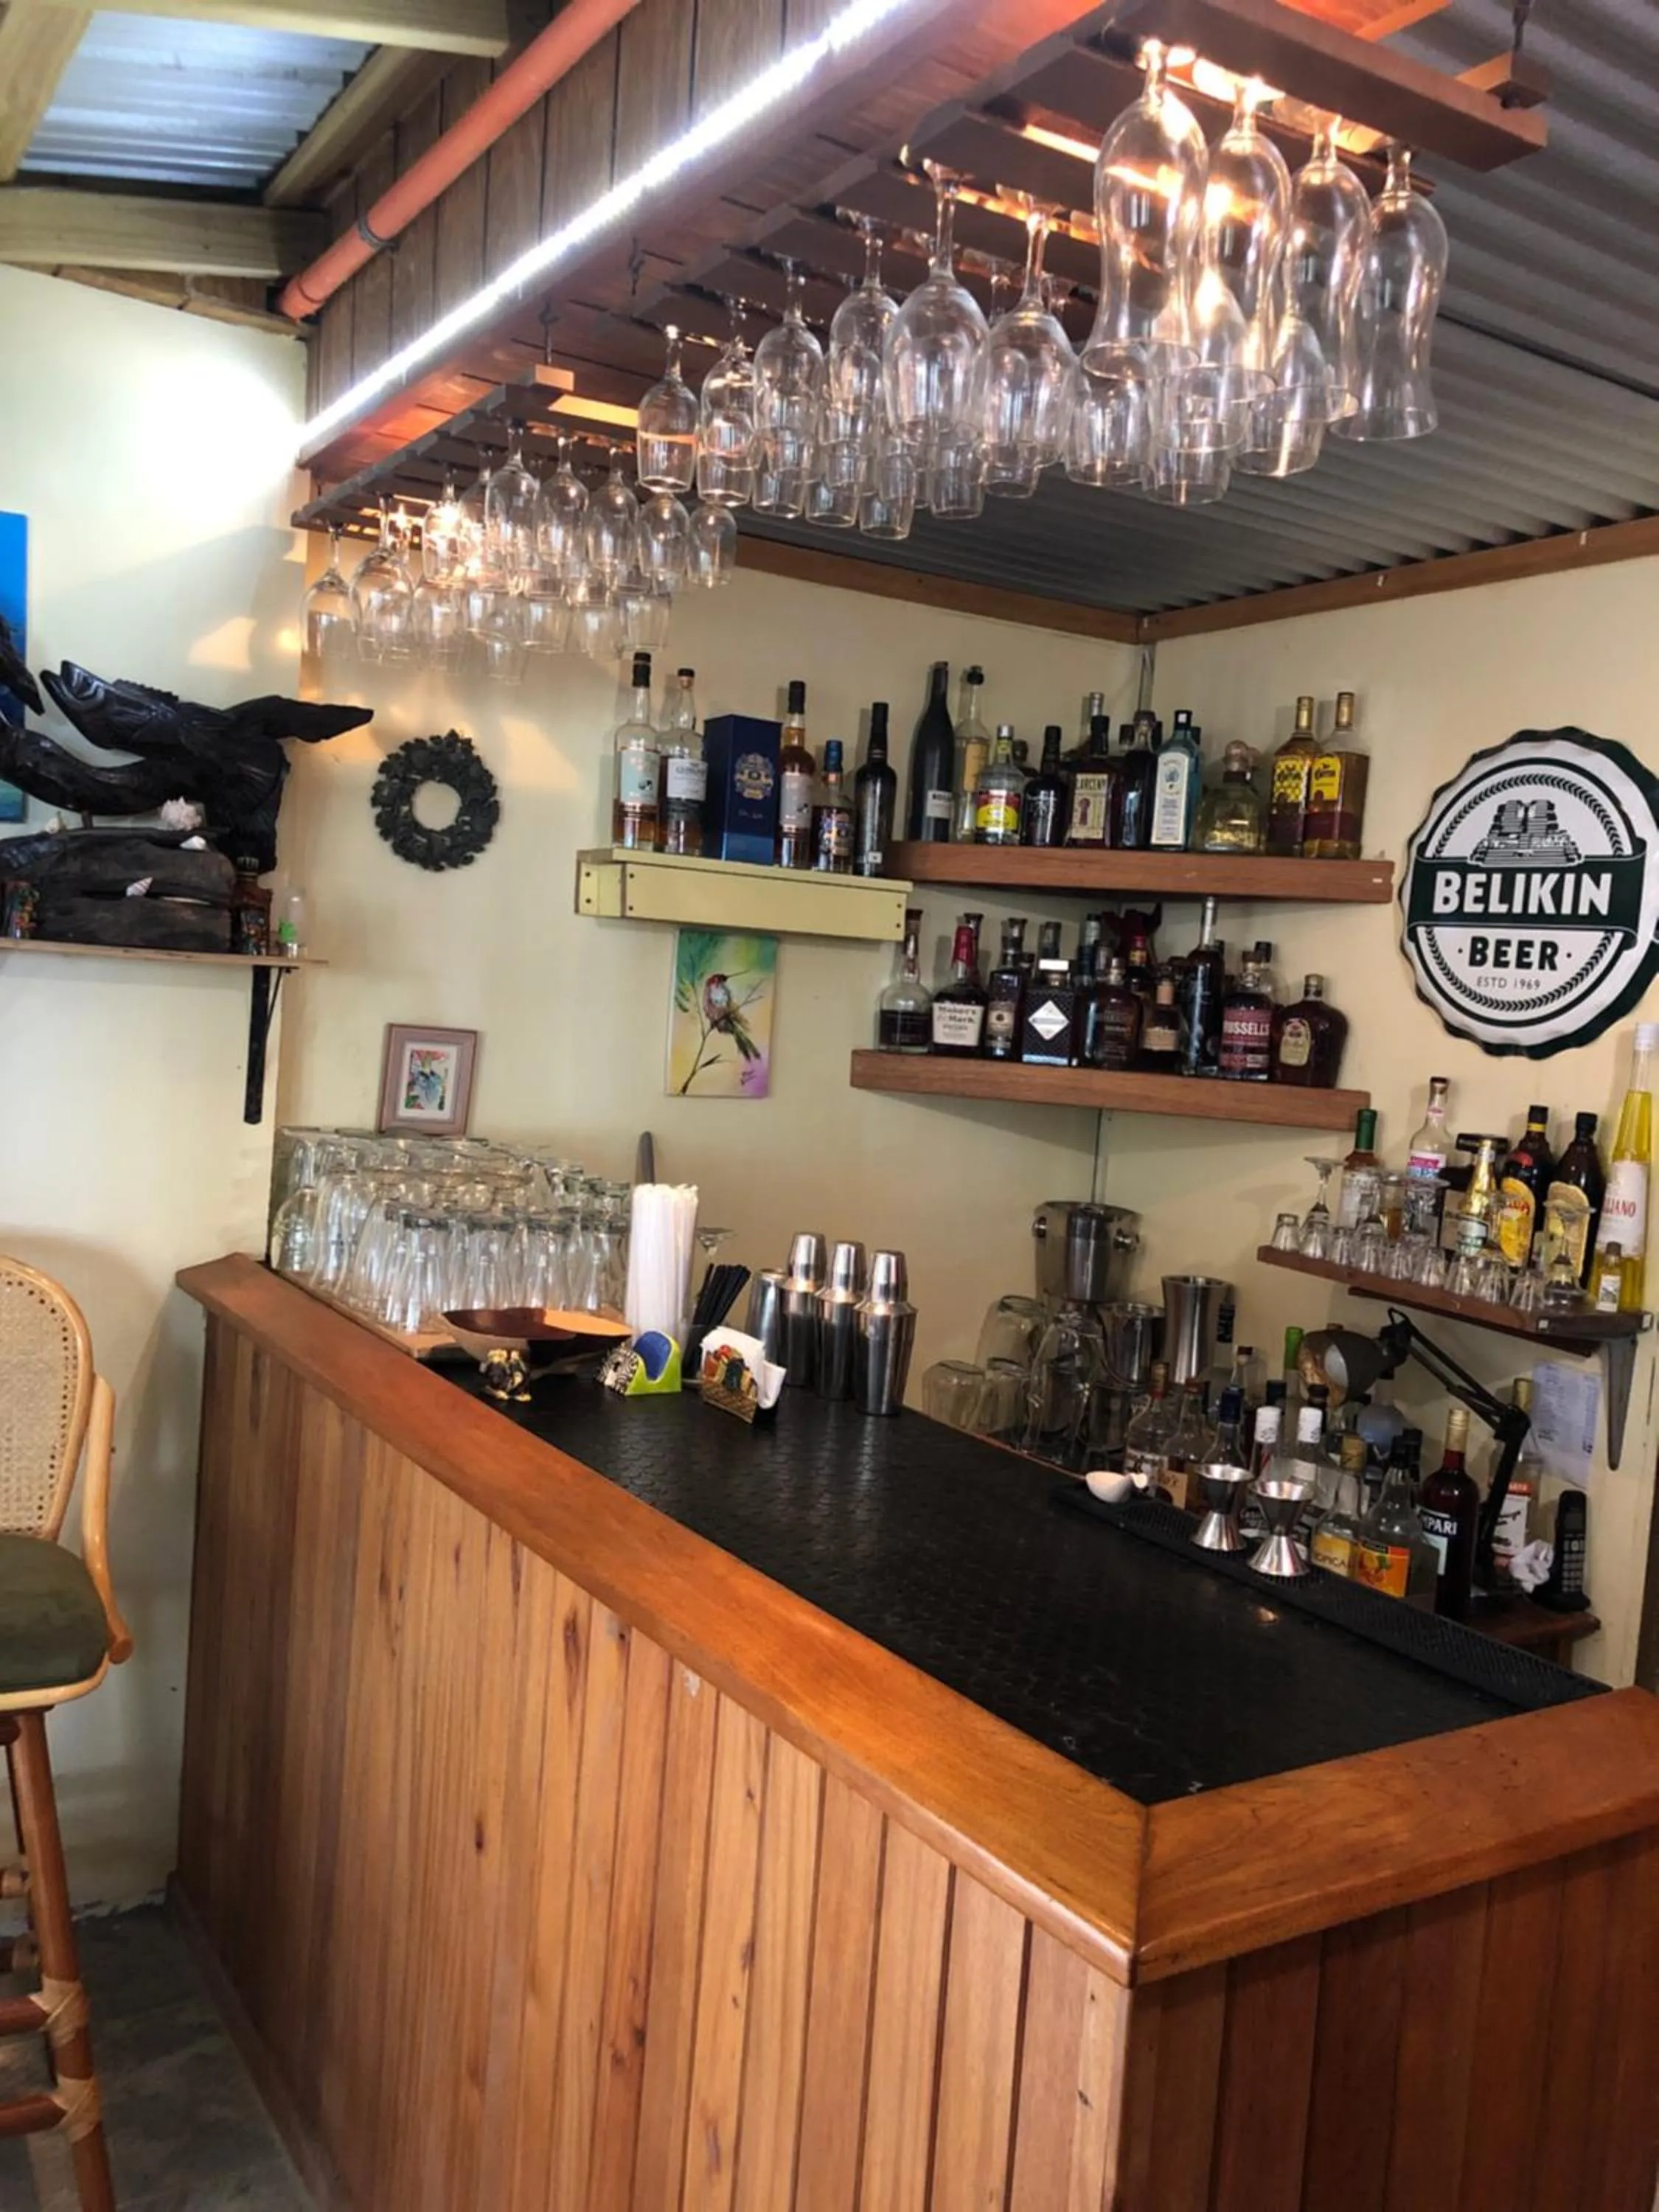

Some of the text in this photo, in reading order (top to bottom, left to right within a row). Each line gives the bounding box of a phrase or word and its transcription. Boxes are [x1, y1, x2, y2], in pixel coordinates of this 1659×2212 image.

[1432, 871, 1613, 916] BELIKIN
[1468, 936, 1559, 971] BEER
[1476, 975, 1542, 990] ESTD 1969
